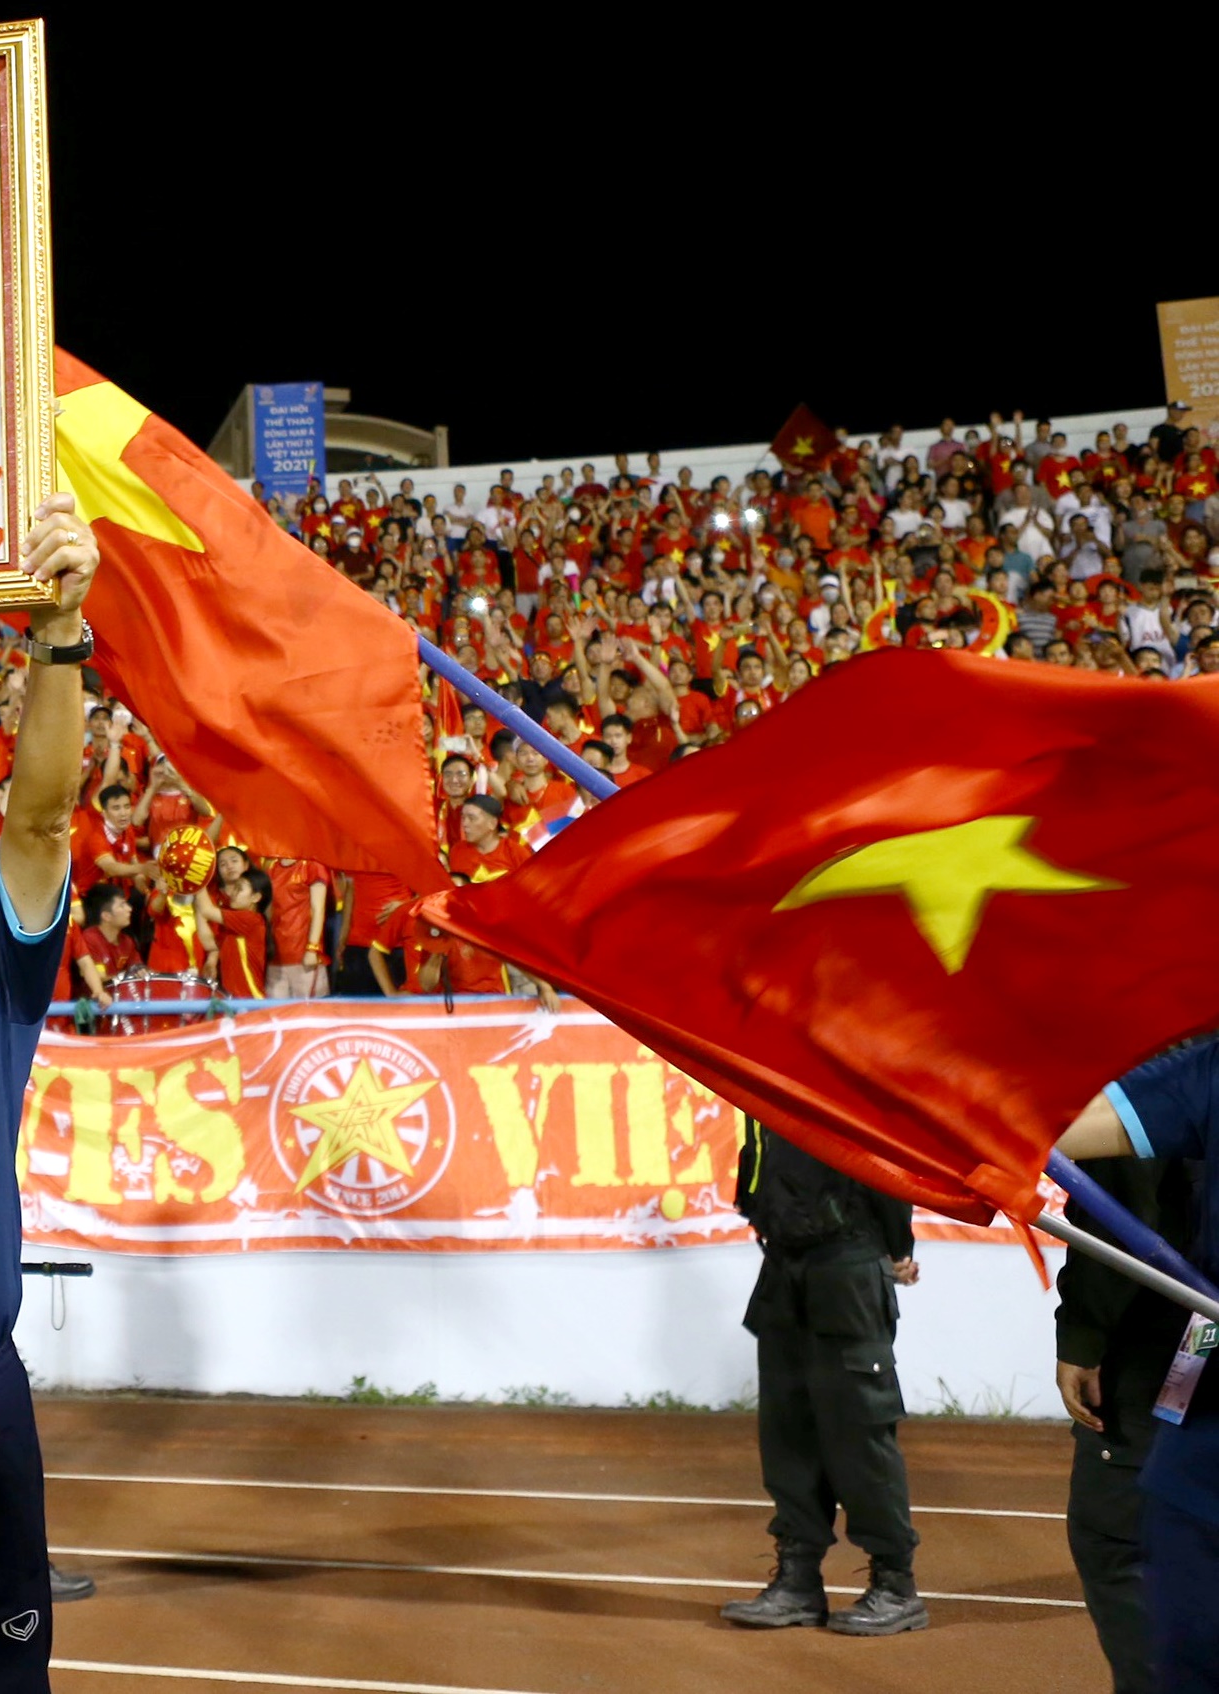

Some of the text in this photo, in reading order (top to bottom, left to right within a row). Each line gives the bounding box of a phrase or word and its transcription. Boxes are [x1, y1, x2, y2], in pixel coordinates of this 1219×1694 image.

[273, 459, 308, 473] 2021
[335, 1040, 424, 1079] SUPPORTERS
[1202, 1327, 1217, 1343] 21
